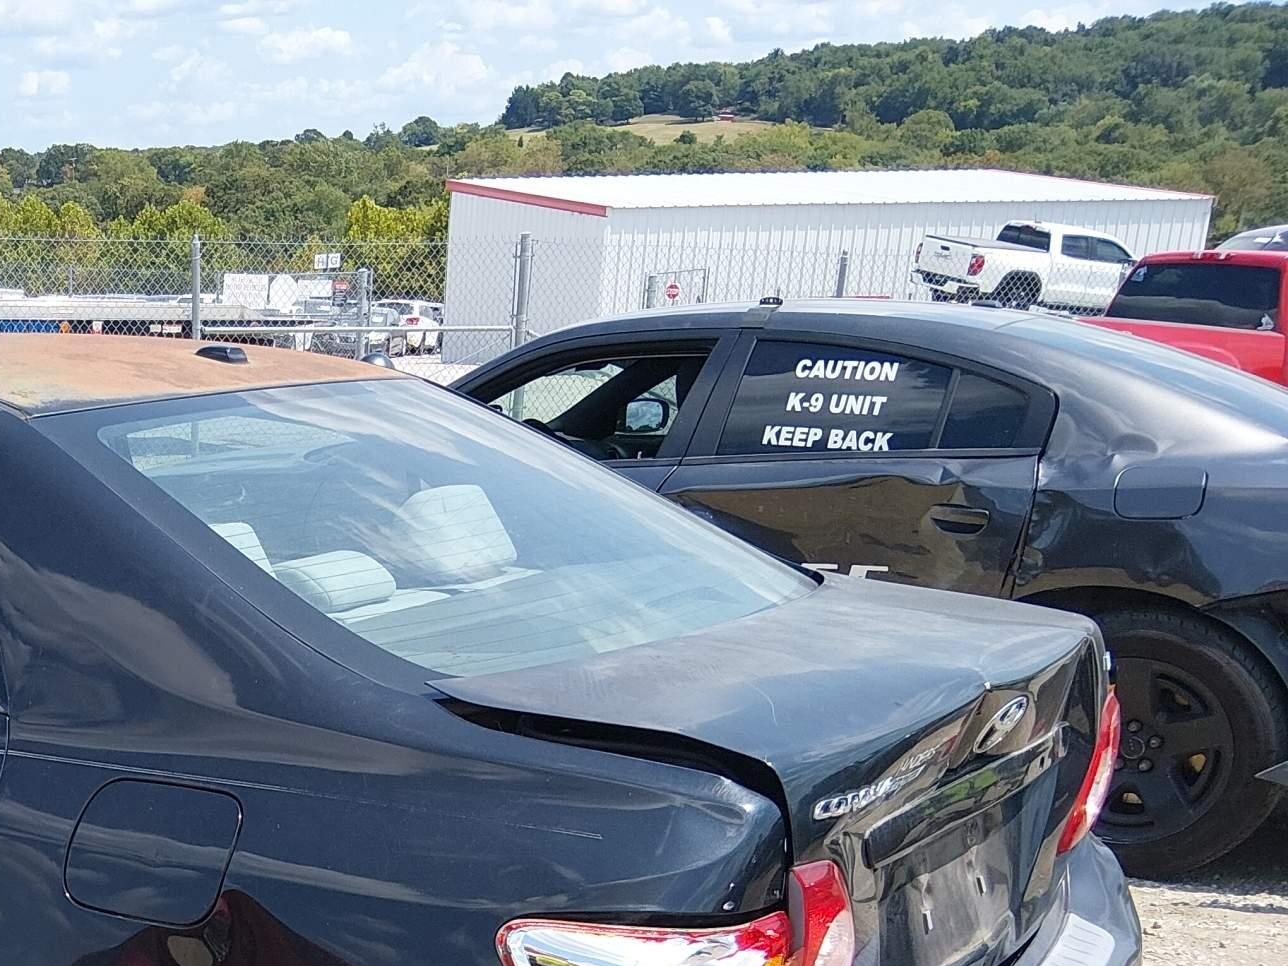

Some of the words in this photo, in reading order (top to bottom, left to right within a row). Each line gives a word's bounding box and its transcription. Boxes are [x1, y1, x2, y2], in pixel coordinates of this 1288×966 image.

[795, 359, 899, 382] CAUTION
[786, 392, 824, 413] K-9
[829, 394, 888, 416] UNIT
[762, 425, 823, 448] KEEP
[827, 429, 894, 452] BACK
